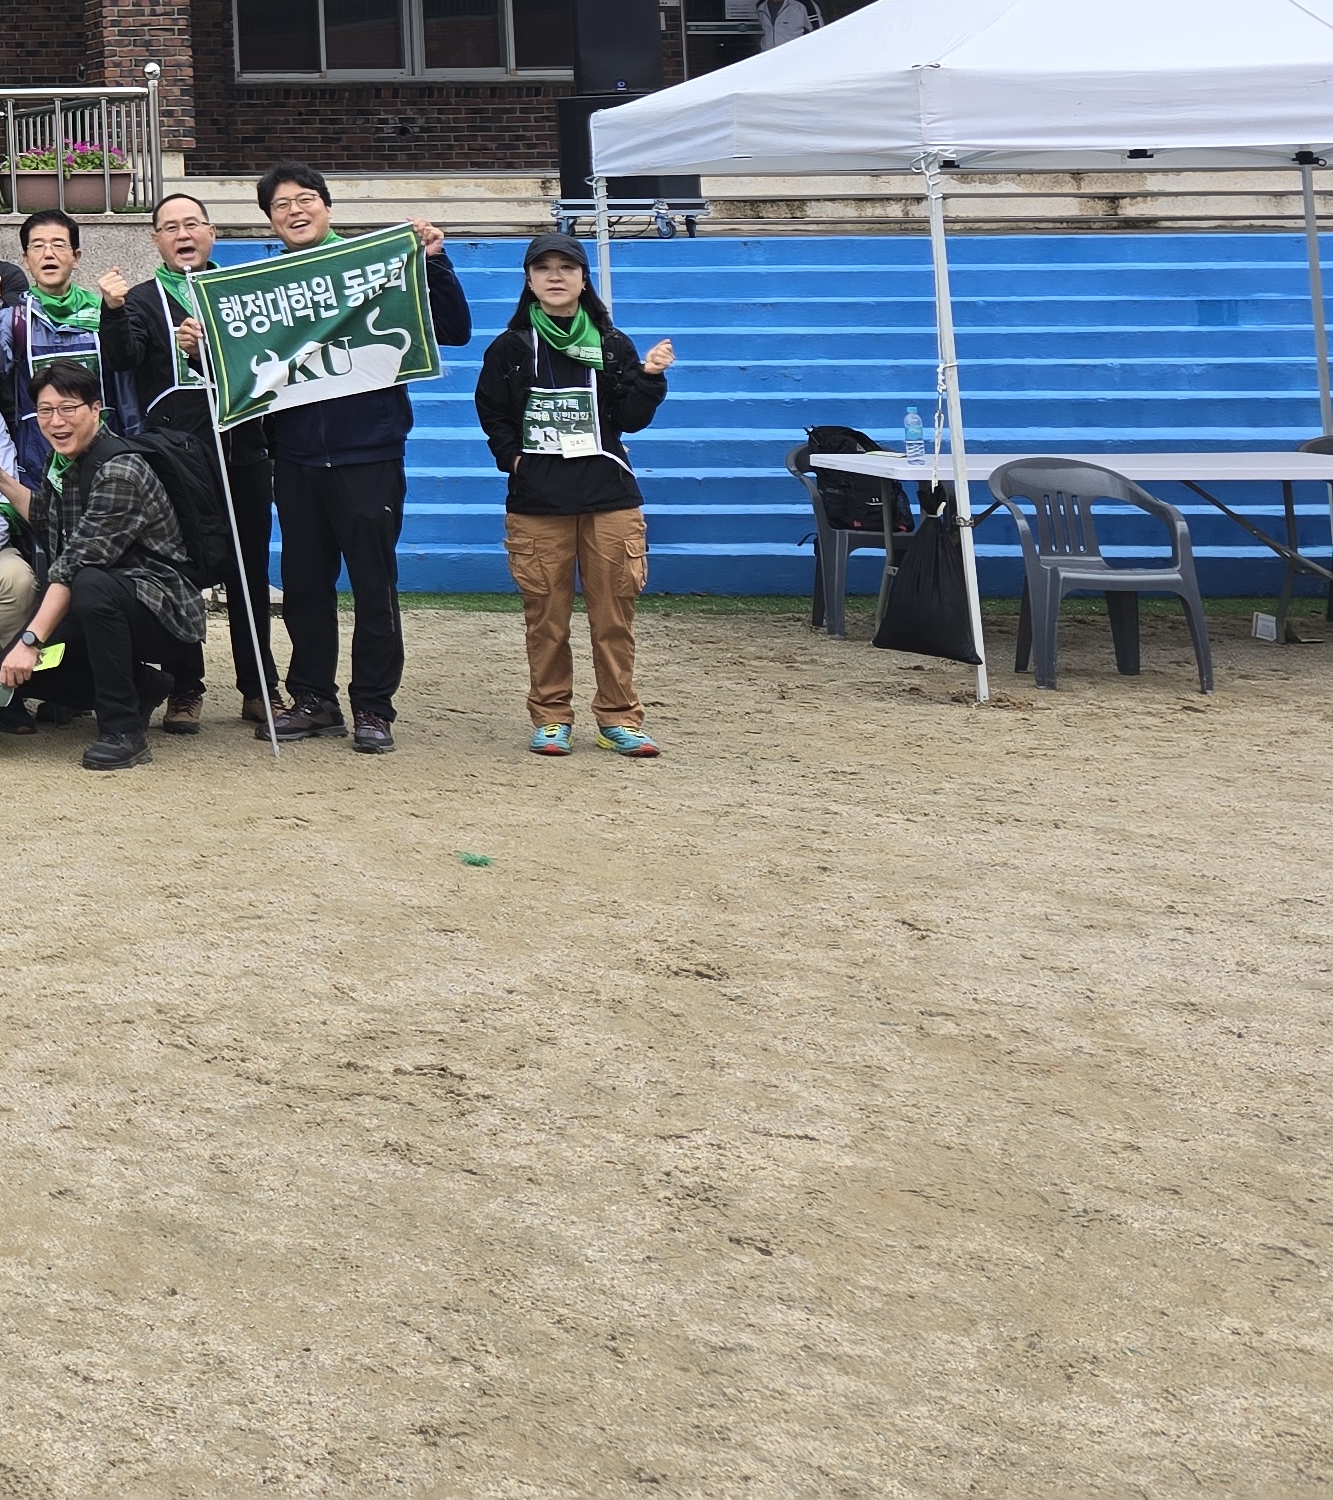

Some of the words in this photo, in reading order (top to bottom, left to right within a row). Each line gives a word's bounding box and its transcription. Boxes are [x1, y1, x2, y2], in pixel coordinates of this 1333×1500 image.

[218, 275, 339, 338] 행정대학원
[342, 253, 408, 308] 동문회
[284, 336, 353, 388] KU
